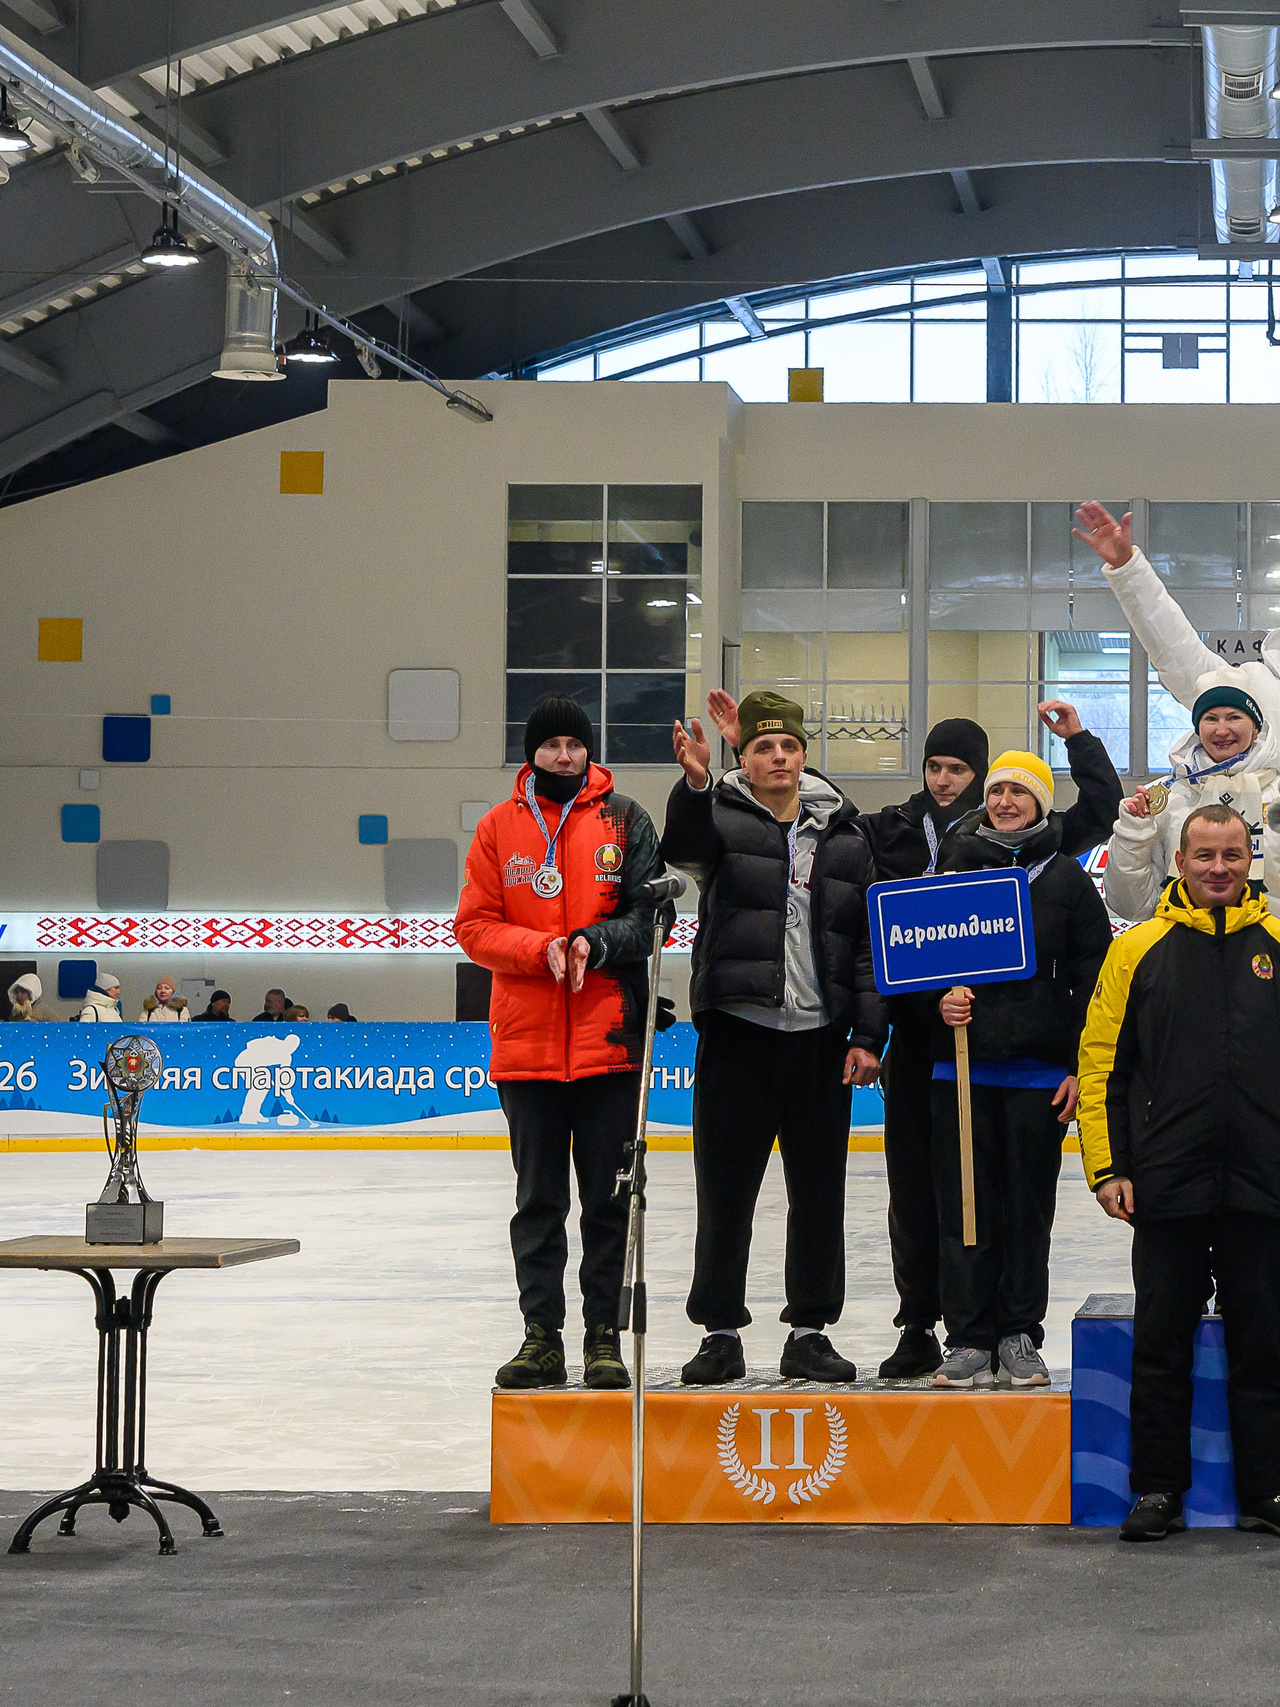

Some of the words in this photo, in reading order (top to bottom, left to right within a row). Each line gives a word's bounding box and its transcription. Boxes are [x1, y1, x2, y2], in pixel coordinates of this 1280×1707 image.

[1216, 639, 1263, 654] КАФ
[889, 914, 1016, 949] Агрохолдинг
[0, 1060, 39, 1092] 26
[67, 1059, 202, 1092] Зияя
[211, 1065, 435, 1098] спартакиада
[751, 1408, 813, 1470] II
